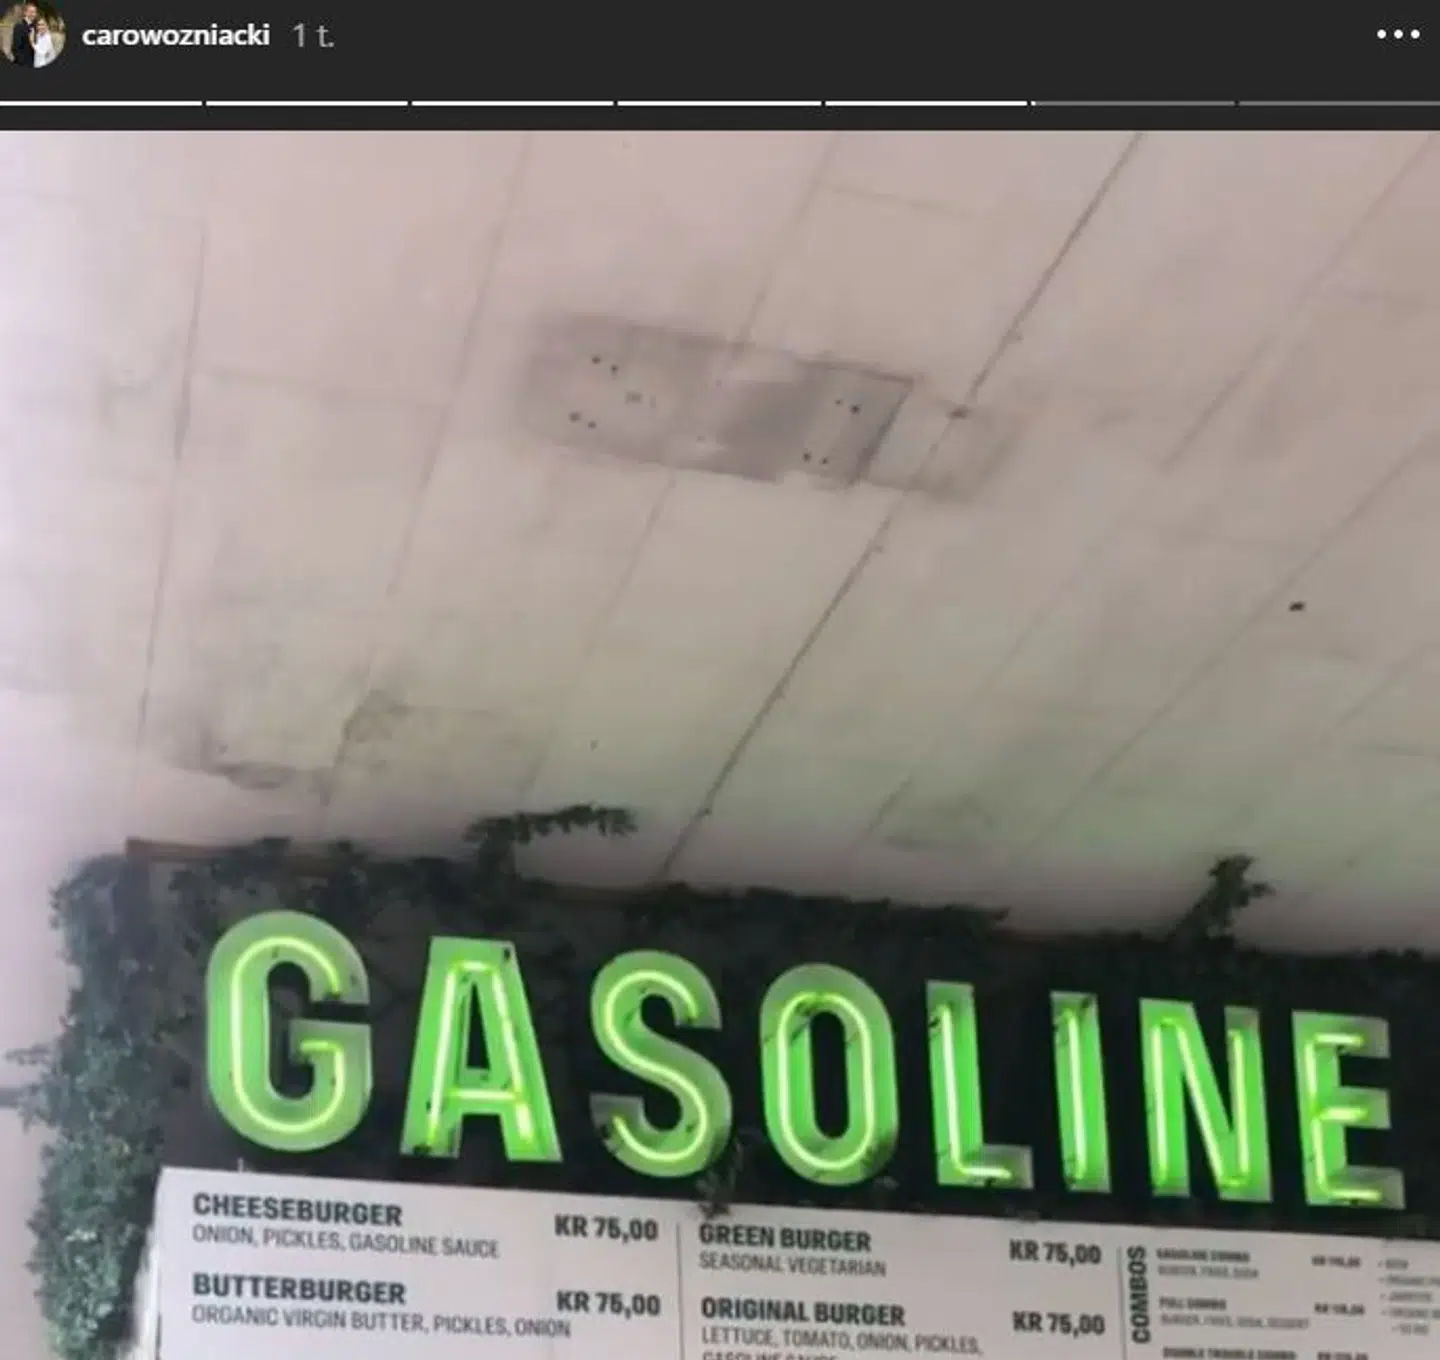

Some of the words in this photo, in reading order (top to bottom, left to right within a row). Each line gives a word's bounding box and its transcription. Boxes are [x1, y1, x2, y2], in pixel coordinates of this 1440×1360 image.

[205, 909, 1404, 1209] GASOLINE
[192, 1191, 403, 1228] CHEESEBURGER
[192, 1223, 260, 1248] ONION,
[263, 1227, 346, 1253] PICKLES,
[349, 1232, 439, 1257] GASOLINE
[442, 1238, 501, 1260] SAUCE
[554, 1213, 589, 1239] KR
[595, 1215, 659, 1243] 75,00
[699, 1222, 775, 1248] GREEN
[780, 1226, 872, 1253] BURGER
[699, 1250, 784, 1274] SEASONAL
[788, 1255, 887, 1278] VEGETARIAN
[1009, 1239, 1039, 1262] KR
[1044, 1242, 1102, 1269] 75,00
[192, 1271, 407, 1306] BUTTERBURGER
[556, 1289, 590, 1314] KR
[596, 1292, 662, 1318] 75,00
[1127, 1245, 1150, 1344] COMBOS
[192, 1304, 279, 1328] ORGANIC
[283, 1307, 347, 1330] VIRGIN
[351, 1311, 430, 1335] BUTTER,
[433, 1314, 512, 1338] PICKLES,
[515, 1316, 572, 1339] ONION
[701, 1296, 810, 1324] ORIGINAL
[815, 1300, 906, 1327] BURGER
[1013, 1311, 1043, 1334] KR
[1048, 1314, 1107, 1339] 75,00
[701, 1325, 778, 1349] LETTUCE,
[783, 1330, 853, 1351] TOMATO,
[856, 1333, 912, 1353] ONION,
[914, 1334, 984, 1357] PICKLES,
